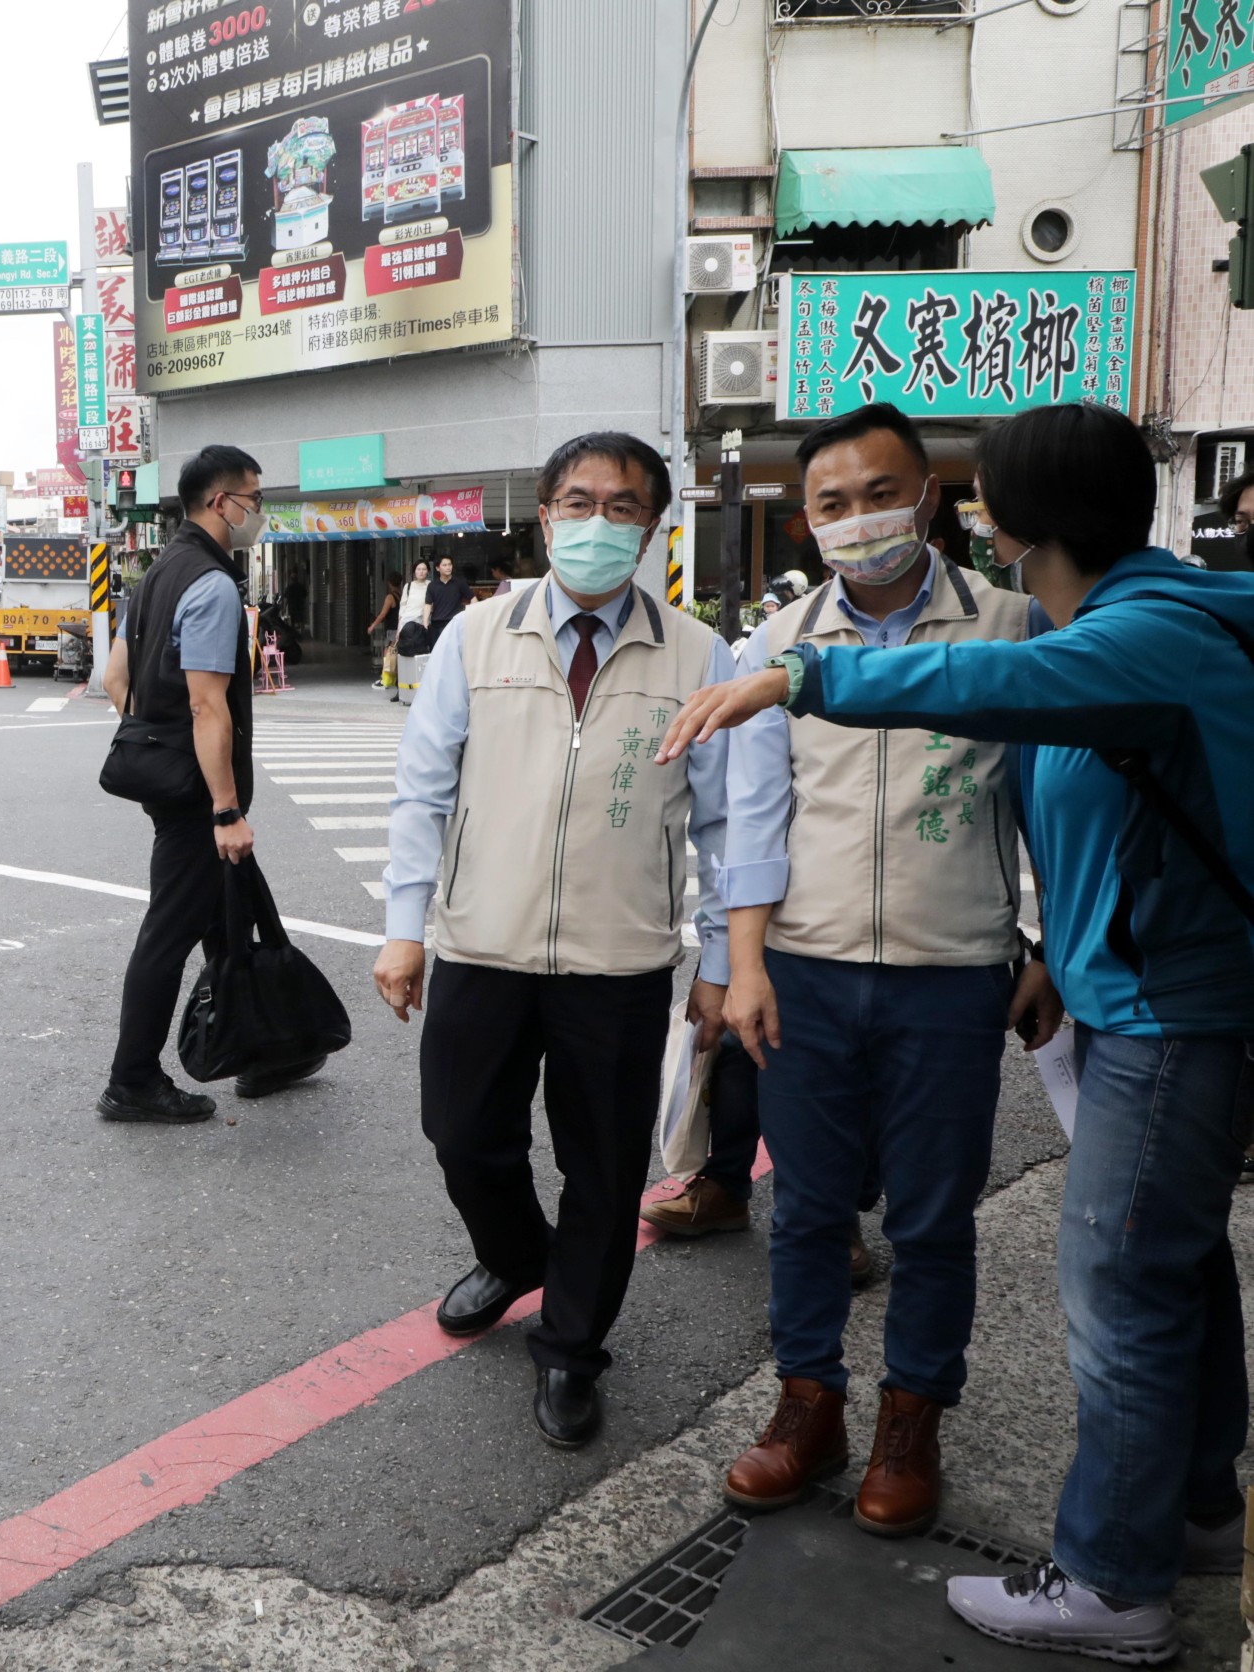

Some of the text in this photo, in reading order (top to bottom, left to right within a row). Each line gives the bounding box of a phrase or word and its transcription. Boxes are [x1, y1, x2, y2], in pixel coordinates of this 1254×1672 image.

[147, 0, 239, 33] 新會好禮
[204, 34, 413, 123] 會員獨享每月精緻禮品
[395, 223, 432, 240] 彩光小丑
[20, 270, 33, 279] Rd.
[392, 261, 436, 282] 引領風潮
[57, 288, 67, 299] 南
[15, 299, 53, 309] 143-107
[83, 317, 97, 330] 東
[84, 342, 96, 351] 220
[841, 290, 1080, 403] 冬寒檳榔
[147, 351, 225, 378] 06-2099687
[84, 354, 99, 425] 民權路二段
[397, 512, 413, 523] $60
[459, 503, 479, 517] $50
[339, 516, 354, 527] $60
[606, 727, 644, 828] 黃偉哲
